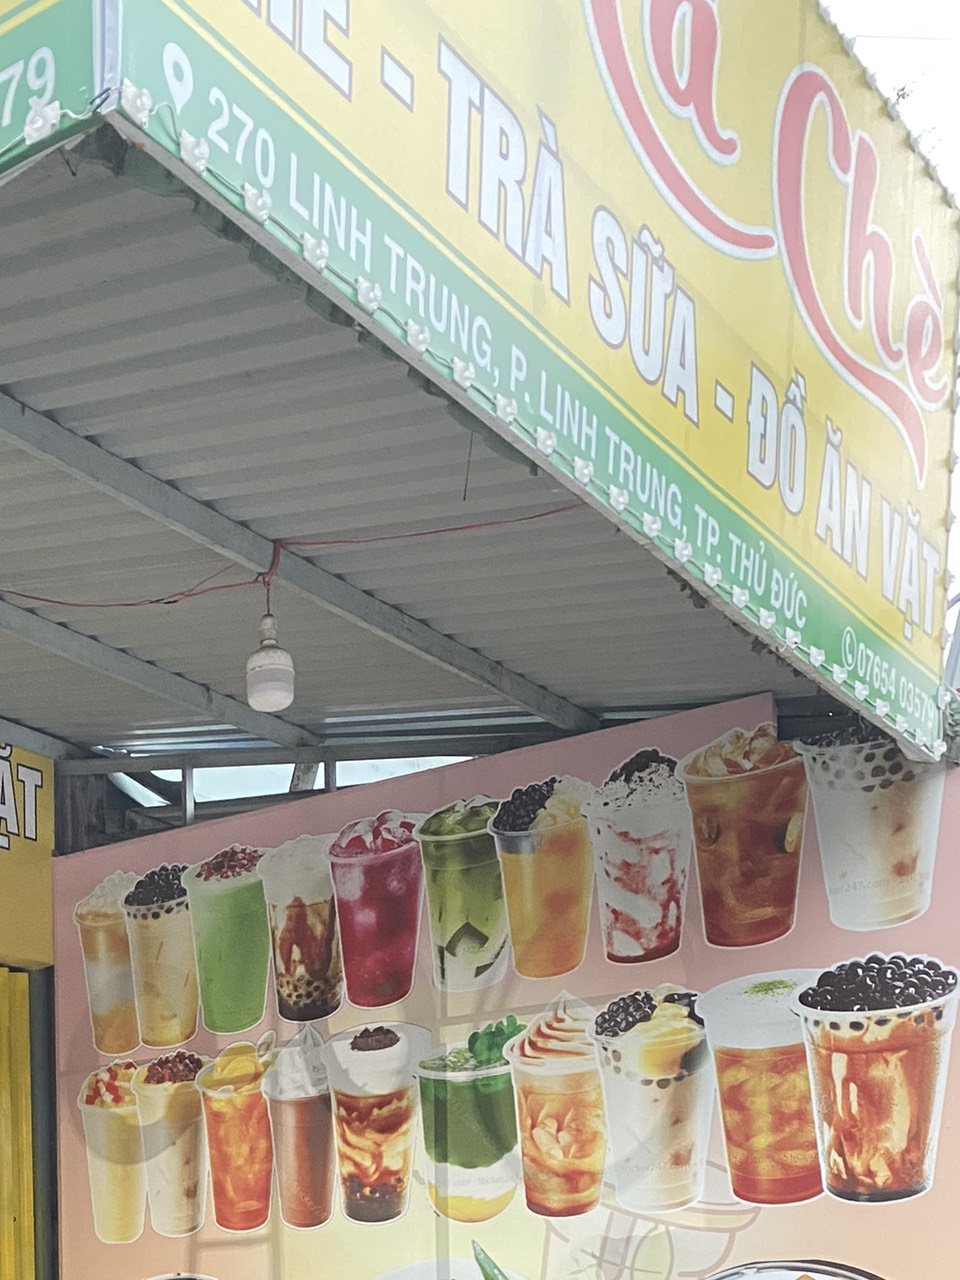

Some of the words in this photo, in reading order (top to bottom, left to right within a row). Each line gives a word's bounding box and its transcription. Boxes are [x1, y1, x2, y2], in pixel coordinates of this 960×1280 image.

[207, 86, 276, 188] 270
[289, 151, 373, 274] LINH
[383, 233, 500, 388] TRUNG,
[509, 343, 530, 404] P.
[540, 370, 598, 460] LINH
[605, 425, 687, 540] TRUNG,
[694, 503, 722, 563] TP.
[728, 531, 768, 598] THỦ
[771, 571, 808, 630] ĐỨC
[857, 642, 897, 700] 07654
[900, 676, 935, 729] 03579
[437, 33, 571, 308] TRÀ
[587, 204, 700, 429] SỮA
[745, 362, 808, 517] ĐỒ
[814, 414, 872, 581] ĂN
[880, 500, 941, 642] VẶT
